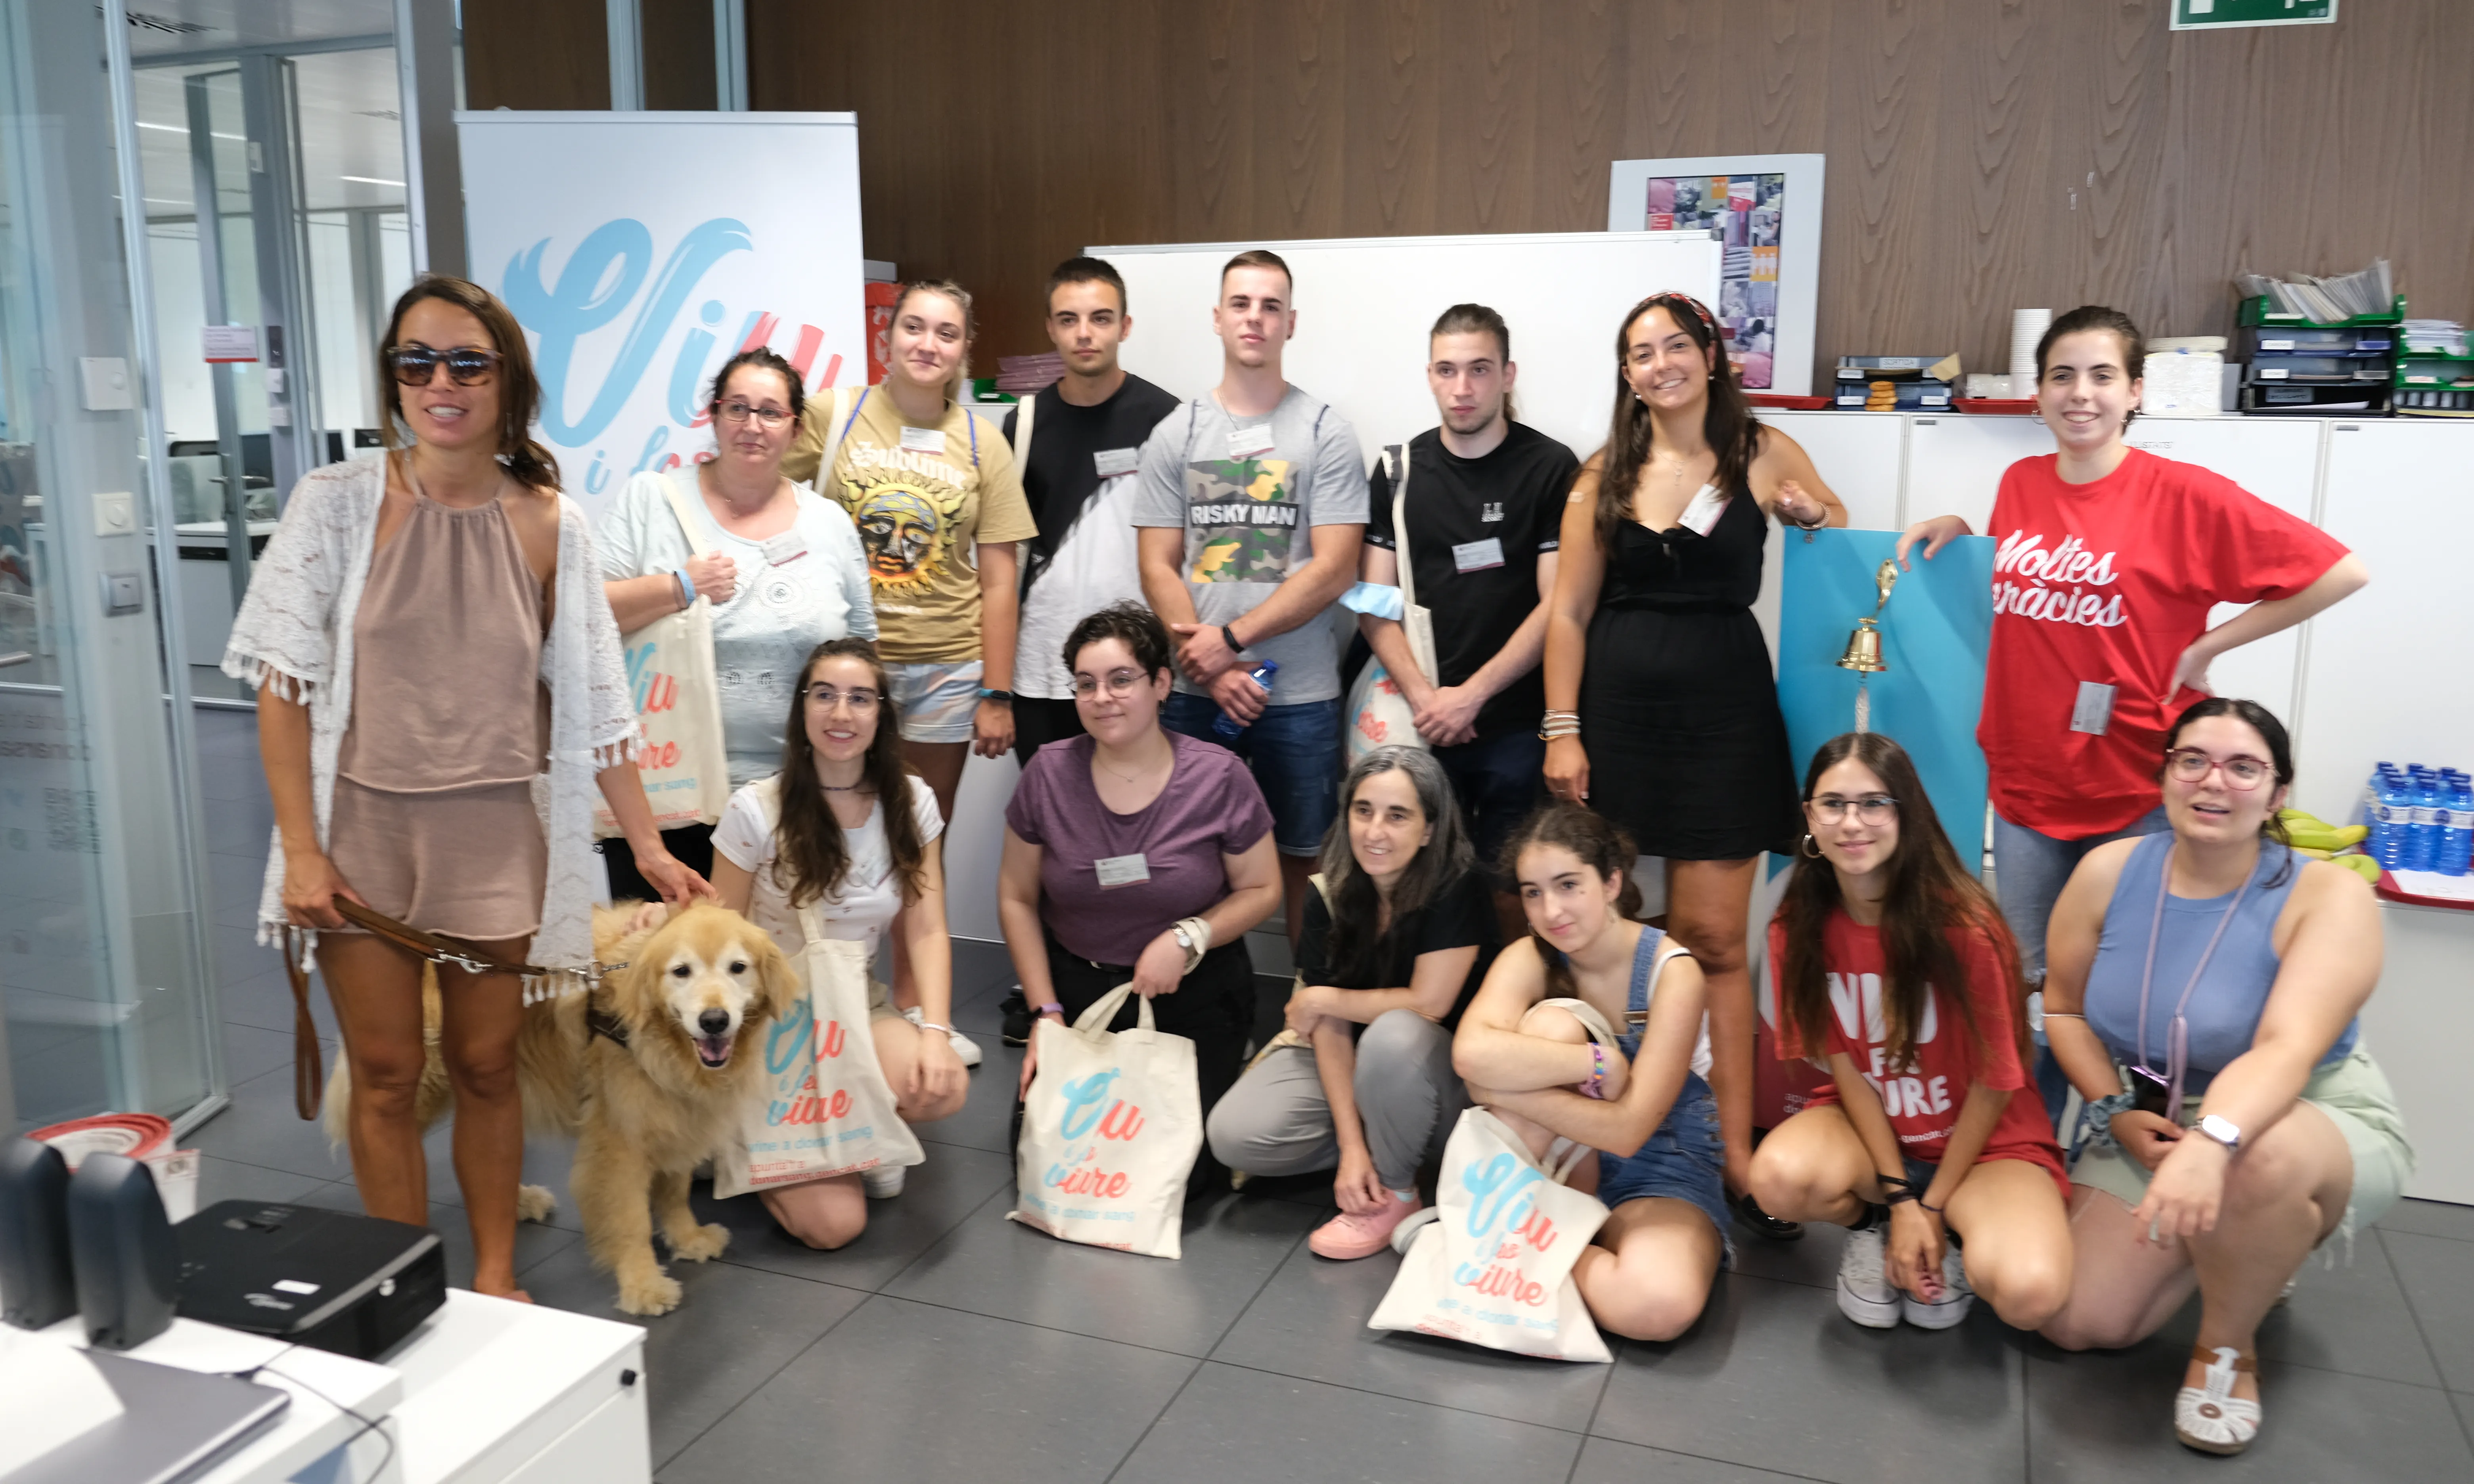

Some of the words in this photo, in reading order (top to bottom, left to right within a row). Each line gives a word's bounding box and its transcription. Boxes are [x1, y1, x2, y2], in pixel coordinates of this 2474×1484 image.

[1191, 504, 1250, 524] RISKY
[1251, 505, 1297, 526] MAN
[1993, 529, 2119, 585] Moltes
[1462, 1151, 1558, 1253] Viu
[1454, 1261, 1549, 1307] viure
